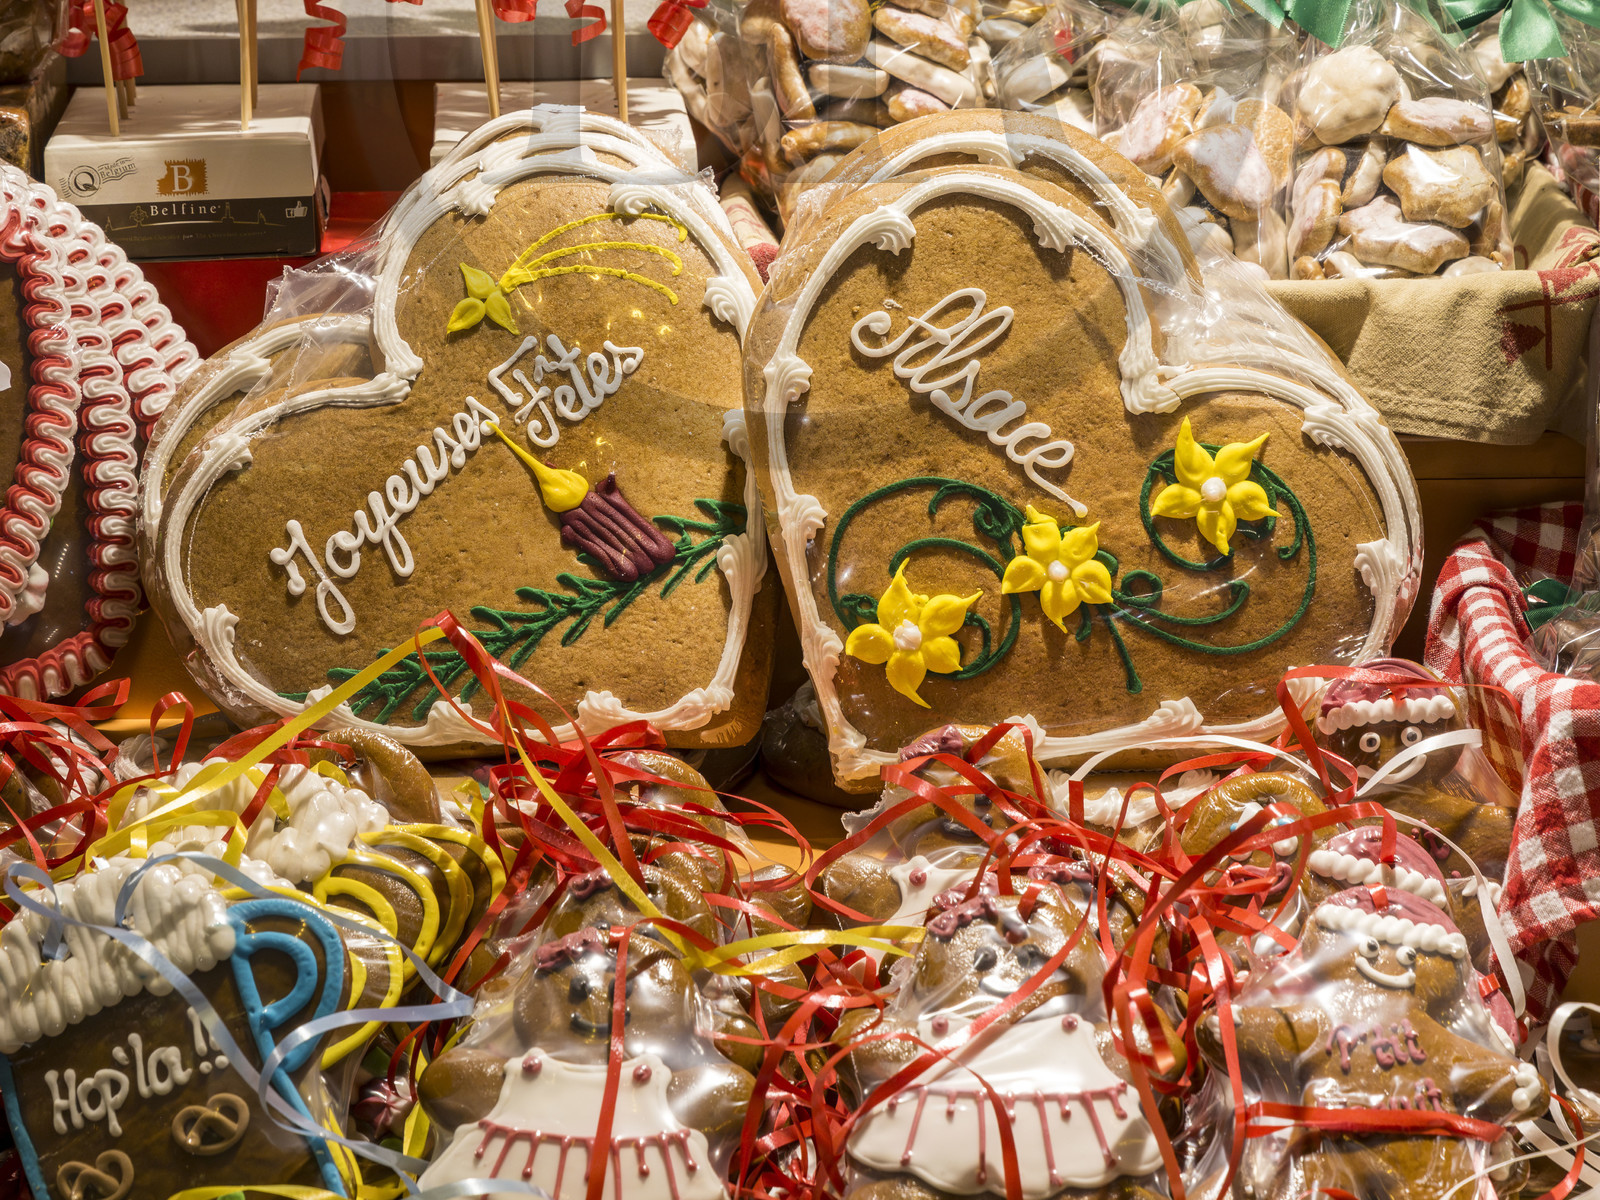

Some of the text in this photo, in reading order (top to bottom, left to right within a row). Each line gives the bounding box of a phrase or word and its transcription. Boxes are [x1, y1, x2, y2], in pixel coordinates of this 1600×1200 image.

[100, 162, 136, 179] Belgium
[171, 164, 193, 193] B
[150, 203, 221, 217] Belfine
[851, 287, 1088, 518] Alsace
[270, 334, 645, 636] Joyeuses Fêtes
